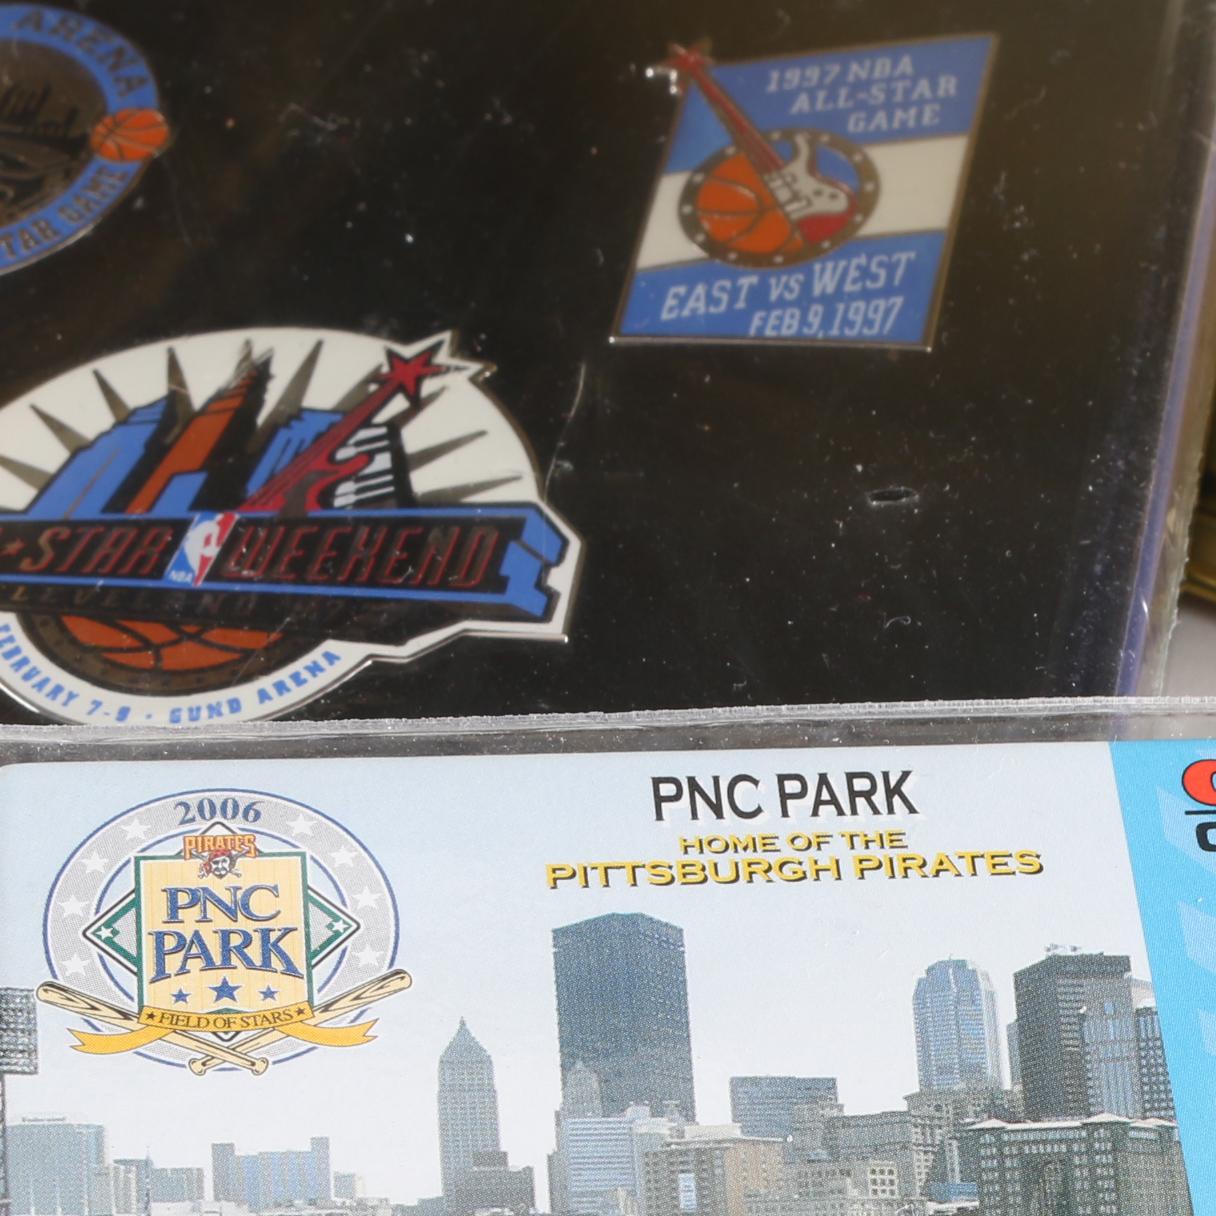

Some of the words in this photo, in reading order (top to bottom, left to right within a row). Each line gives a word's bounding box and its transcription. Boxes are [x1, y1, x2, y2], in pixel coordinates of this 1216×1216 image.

[767, 64, 841, 93] 1997
[848, 55, 914, 83] NBA
[790, 76, 957, 114] ALL-STAR
[848, 105, 941, 132] GAME
[0, 220, 60, 258] TAR
[58, 166, 130, 222] GAME
[661, 276, 758, 321] EAST
[812, 252, 916, 296] WEST
[749, 310, 801, 337] FEB
[221, 526, 499, 588] WEEKEND
[169, 570, 193, 583] NBA
[86, 700, 131, 722] 7-9
[169, 697, 242, 724] GUND
[257, 651, 341, 704] ARENA
[173, 798, 266, 826] 2006
[650, 772, 764, 822] PNC
[775, 769, 921, 819] PARK
[183, 834, 257, 861] PIRATES
[678, 833, 783, 856] HOME
[786, 832, 832, 853] OF
[840, 830, 909, 850] THE
[544, 857, 843, 889] PITTSBURGH
[852, 849, 1045, 883] PIRATES
[160, 884, 282, 924] PNC
[147, 926, 305, 984] PARK
[158, 1011, 210, 1029] FIELD
[213, 1017, 237, 1029] OF
[240, 1008, 294, 1028] STARS
